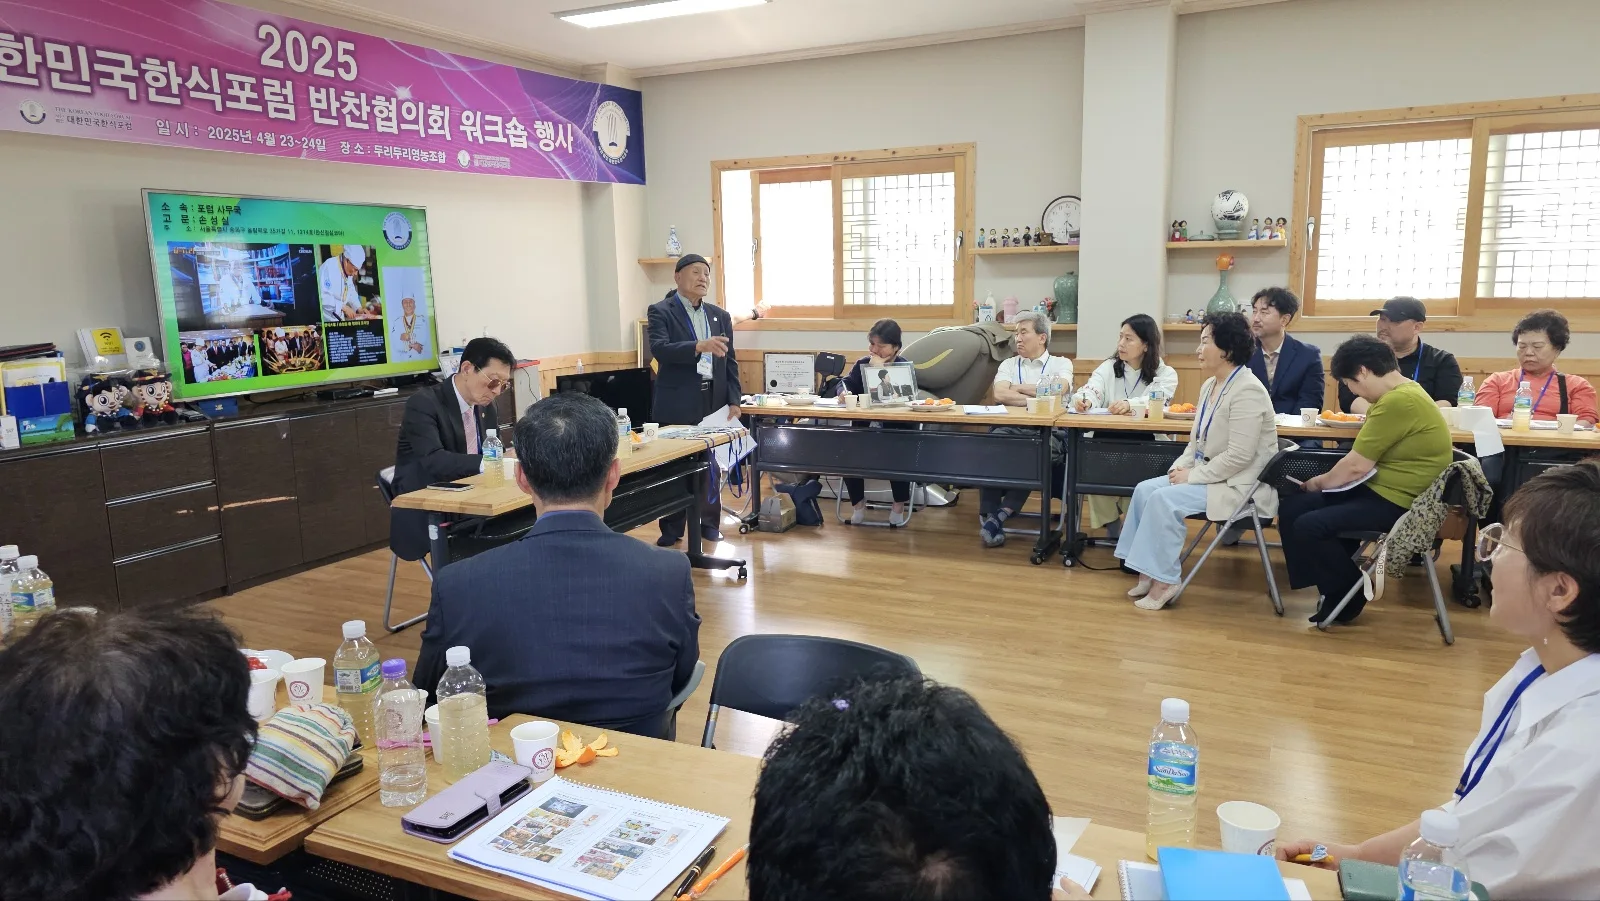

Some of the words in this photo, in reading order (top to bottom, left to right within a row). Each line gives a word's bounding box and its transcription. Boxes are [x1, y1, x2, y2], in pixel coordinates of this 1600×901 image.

[258, 24, 358, 81] 2025
[0, 32, 296, 122] 한민국한식포럼
[308, 85, 452, 140] 반찬협의회
[459, 109, 529, 149] 워크숍
[533, 120, 574, 153] 행사
[66, 115, 133, 131] 대한민국한식포럼
[207, 126, 253, 145] 2025년
[256, 131, 276, 147] 4월
[280, 135, 326, 152] 23~24일
[374, 144, 446, 164] 두리두리영농조합
[197, 204, 214, 214] 포럼
